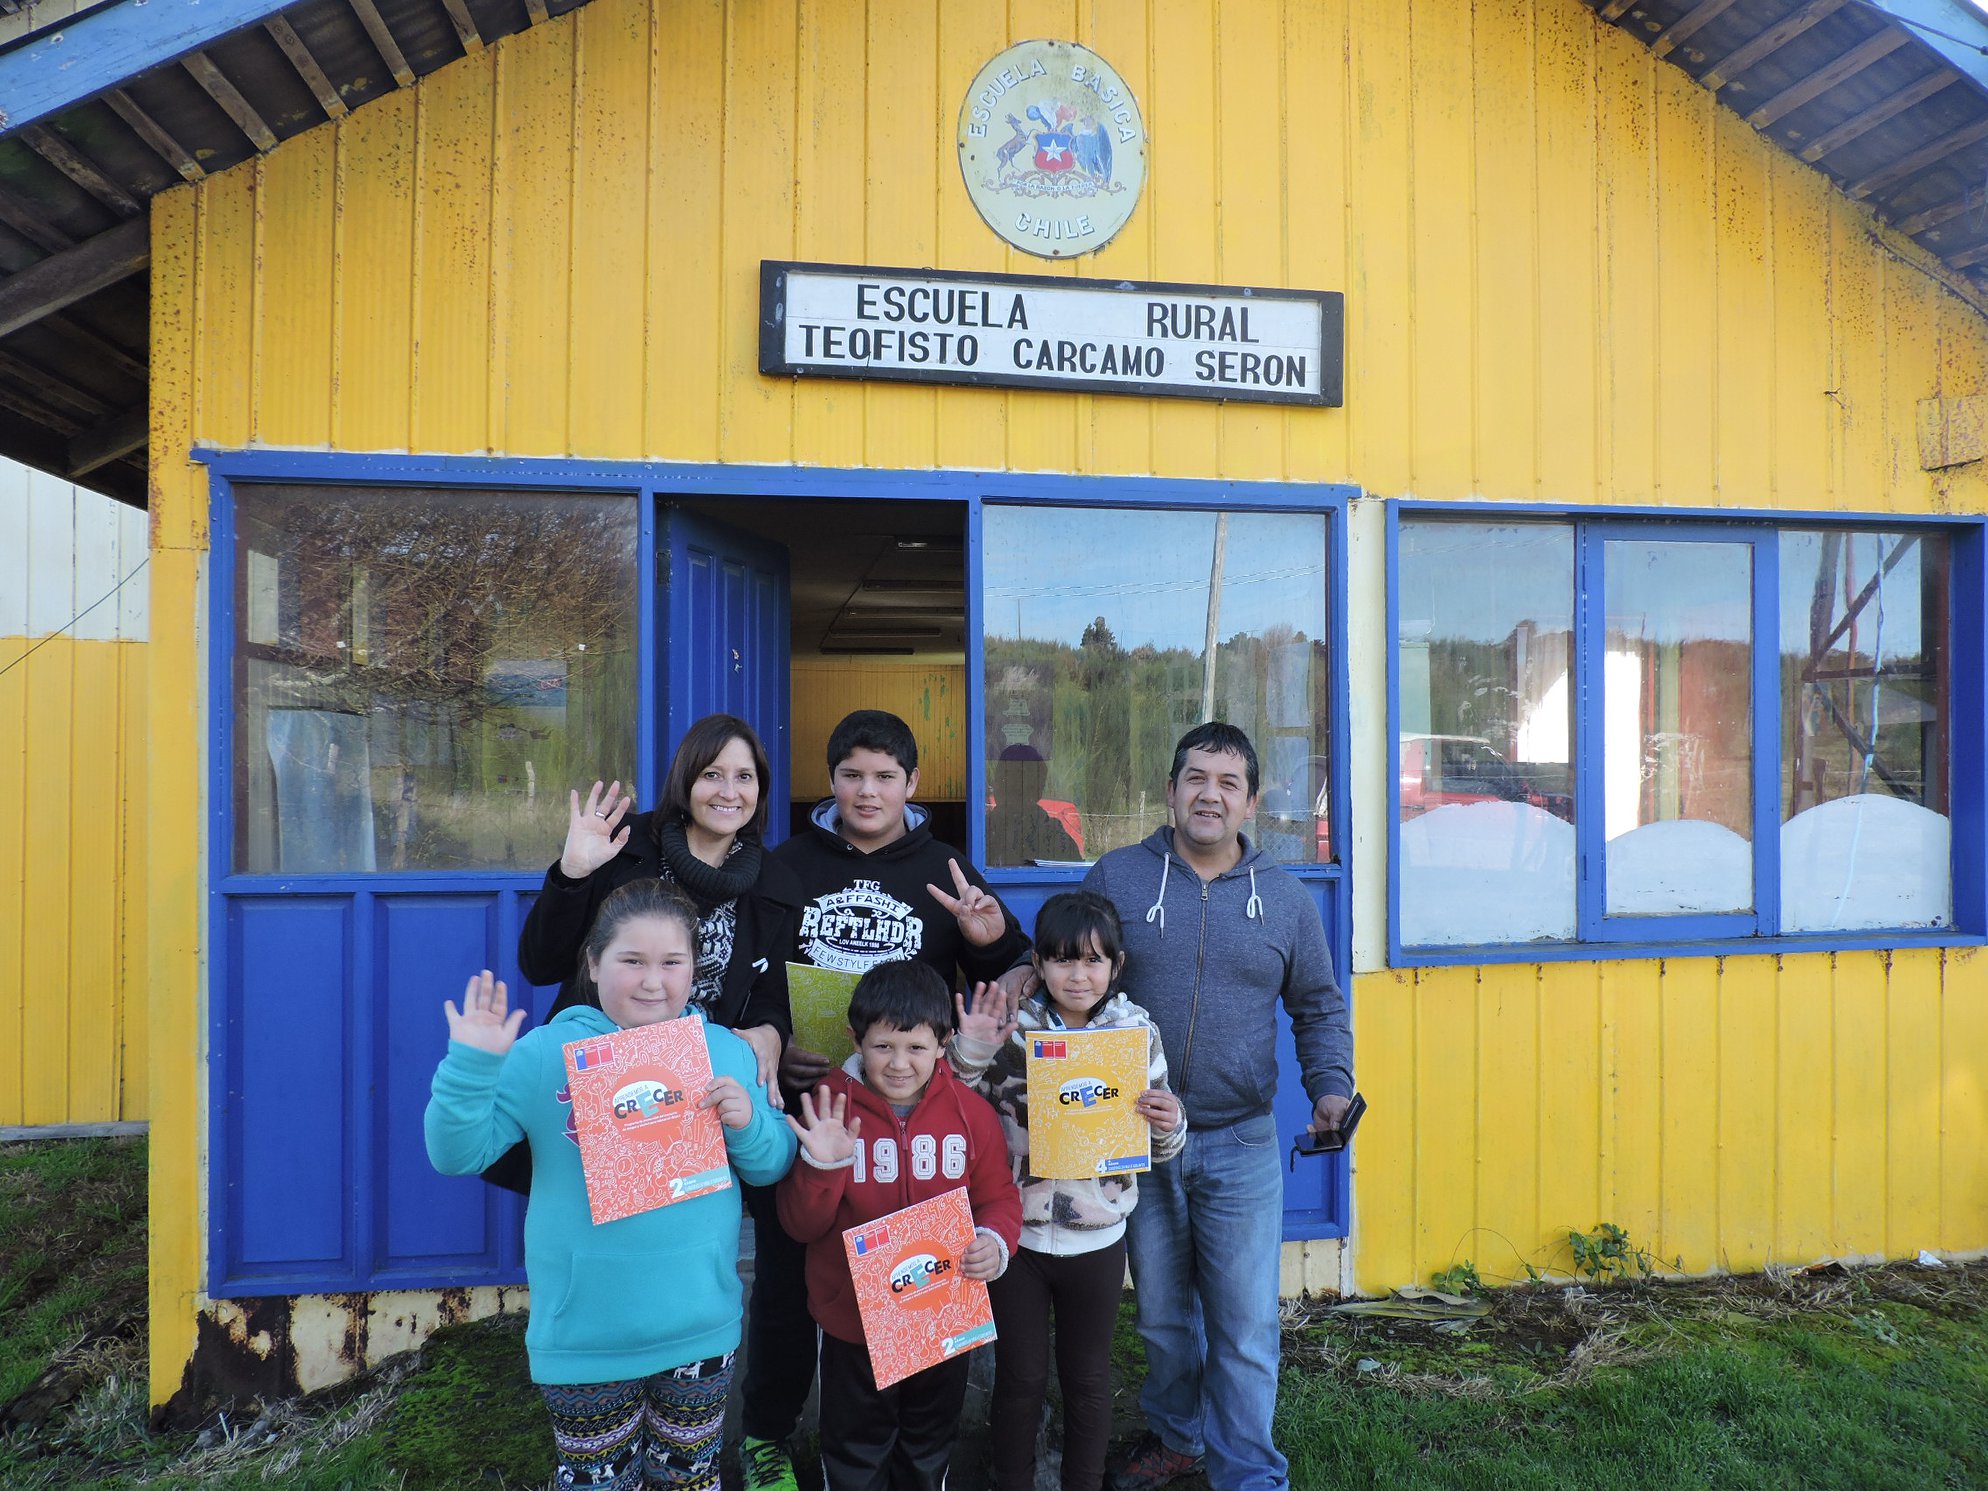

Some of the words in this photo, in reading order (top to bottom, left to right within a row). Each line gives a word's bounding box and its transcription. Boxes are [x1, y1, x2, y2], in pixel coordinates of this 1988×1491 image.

[967, 58, 1047, 139] ESCUELA
[1071, 64, 1137, 144] BASICA
[1015, 213, 1096, 239] CHILE
[857, 284, 1029, 330] ESCUELA
[1146, 302, 1259, 343] RURAL
[798, 324, 979, 367] TEOFISTO
[1013, 338, 1165, 378] CARCAMO
[1195, 350, 1306, 388] SERON
[853, 879, 881, 891] TFG
[614, 1088, 684, 1119] CRECER
[1059, 1085, 1119, 1107] CRECER
[854, 1134, 967, 1183] 1986
[1095, 1158, 1108, 1174] 4
[669, 1178, 686, 1199] 2
[892, 1259, 951, 1293] CRECER
[942, 1337, 956, 1357] 2
